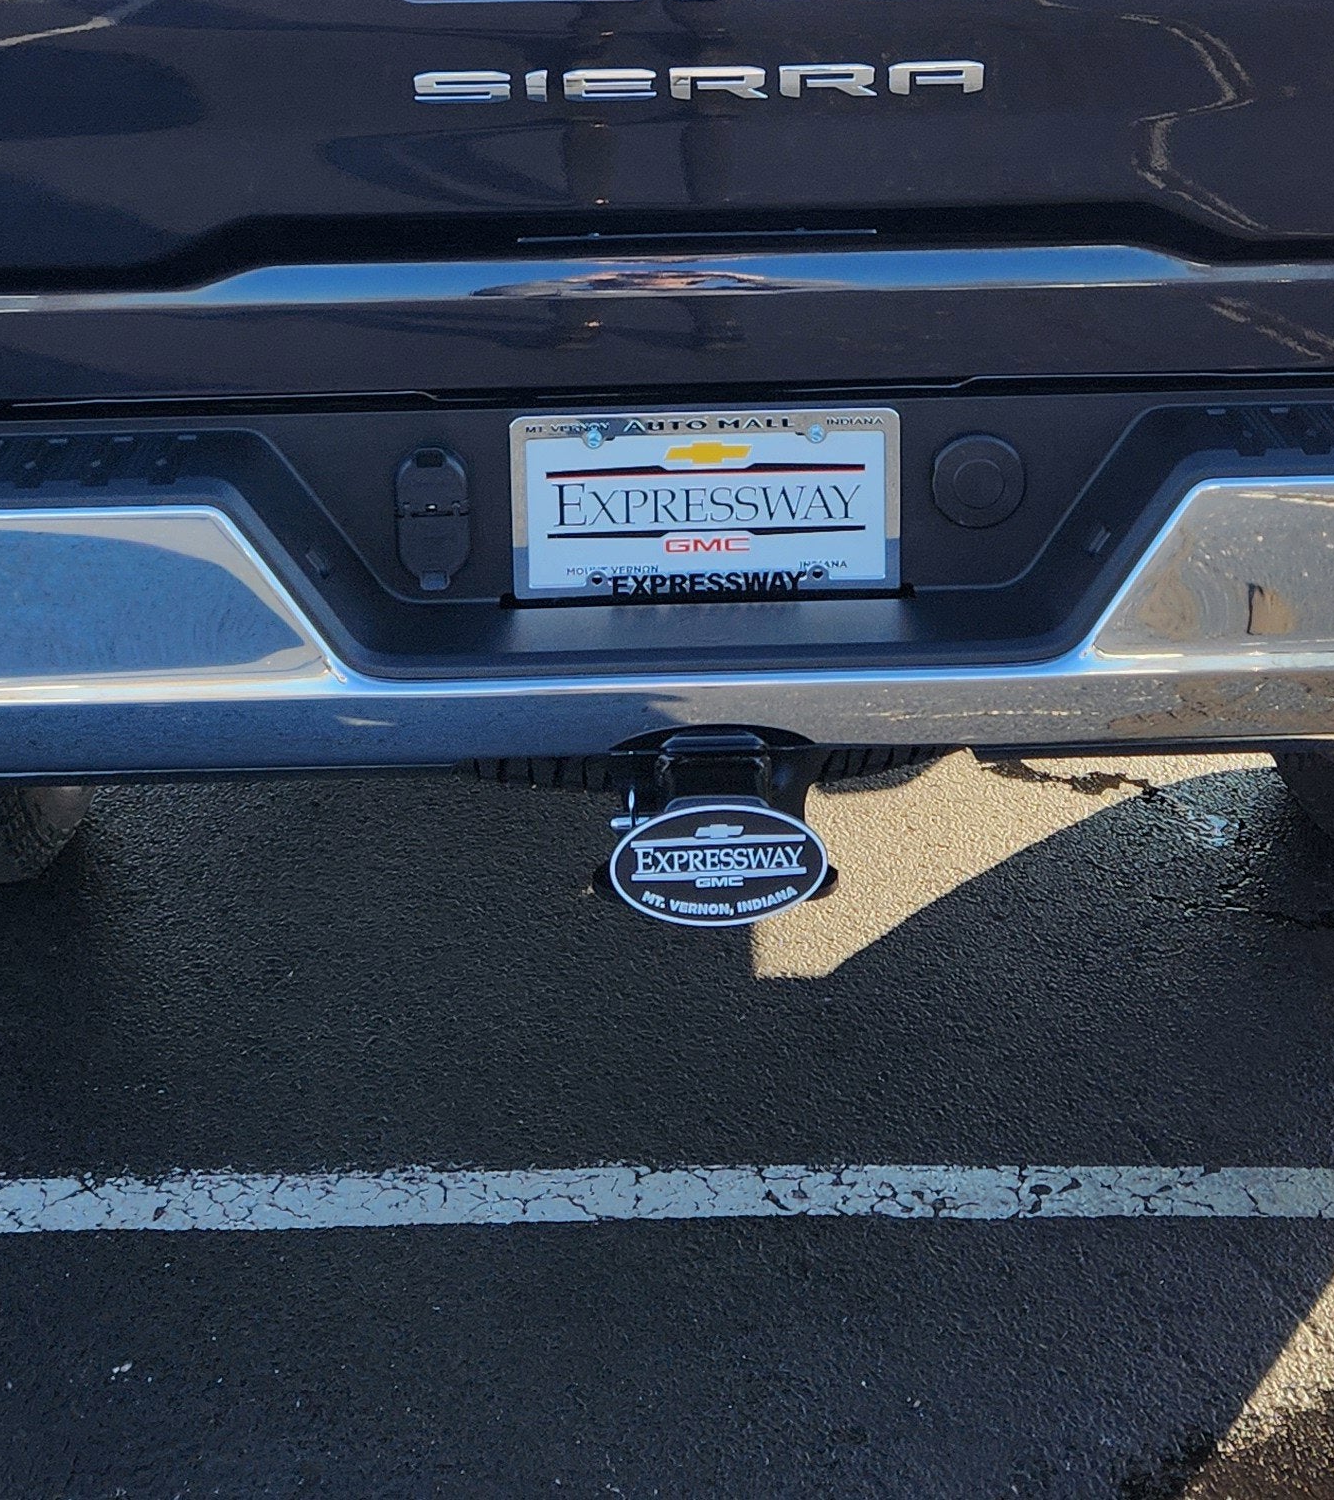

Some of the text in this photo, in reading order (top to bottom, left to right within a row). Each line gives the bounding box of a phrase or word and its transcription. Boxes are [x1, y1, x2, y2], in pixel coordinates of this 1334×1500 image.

[413, 61, 986, 103] SIERRA
[550, 422, 610, 433] VERNON
[623, 416, 795, 433] AUTO MALL
[825, 415, 885, 426] INDIANA
[551, 483, 862, 528] EXPRESSWAY
[664, 537, 751, 553] GMC
[611, 570, 807, 597] EXPRESSWAY
[634, 845, 803, 875] EXPRESSWAY
[695, 876, 744, 888] GMC
[641, 886, 799, 916] MT. VERNON, INDIANA
